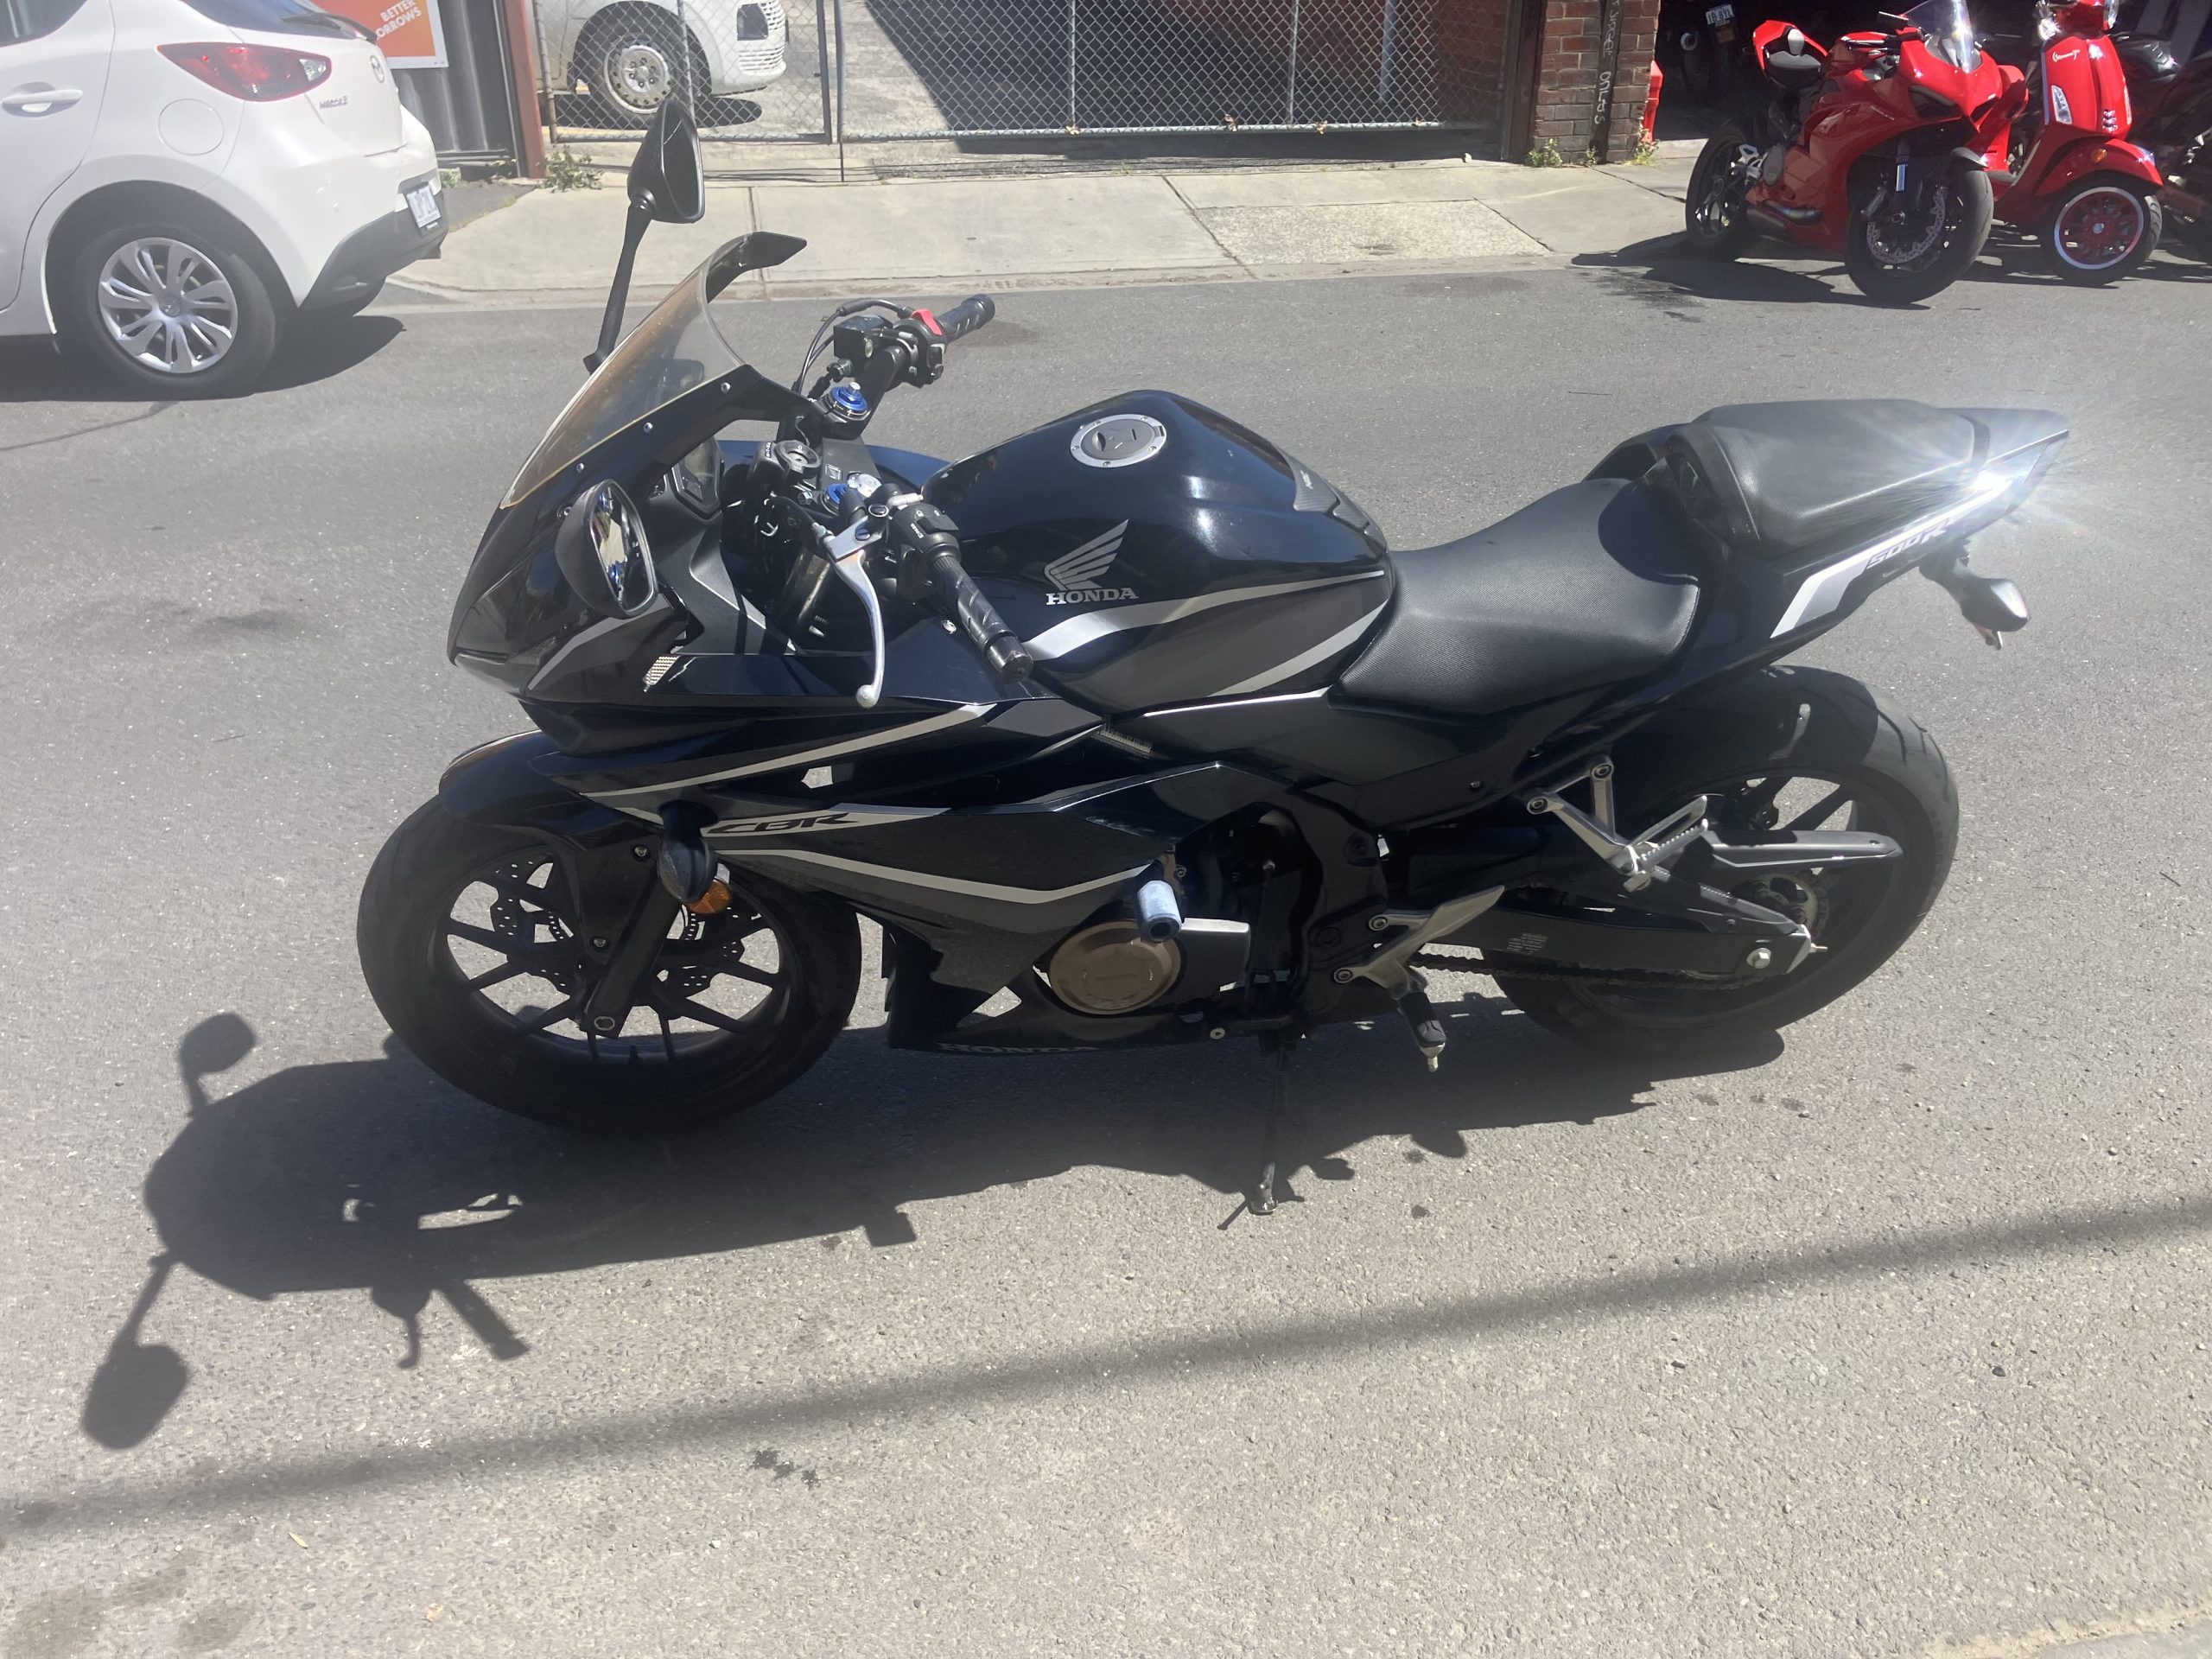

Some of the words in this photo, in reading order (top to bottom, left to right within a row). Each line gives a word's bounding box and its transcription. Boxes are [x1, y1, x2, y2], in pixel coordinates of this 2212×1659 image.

[380, 0, 416, 22] BETTER
[375, 6, 422, 40] ORROWS
[1046, 588, 1140, 606] HONDA
[706, 812, 858, 834] CBR
